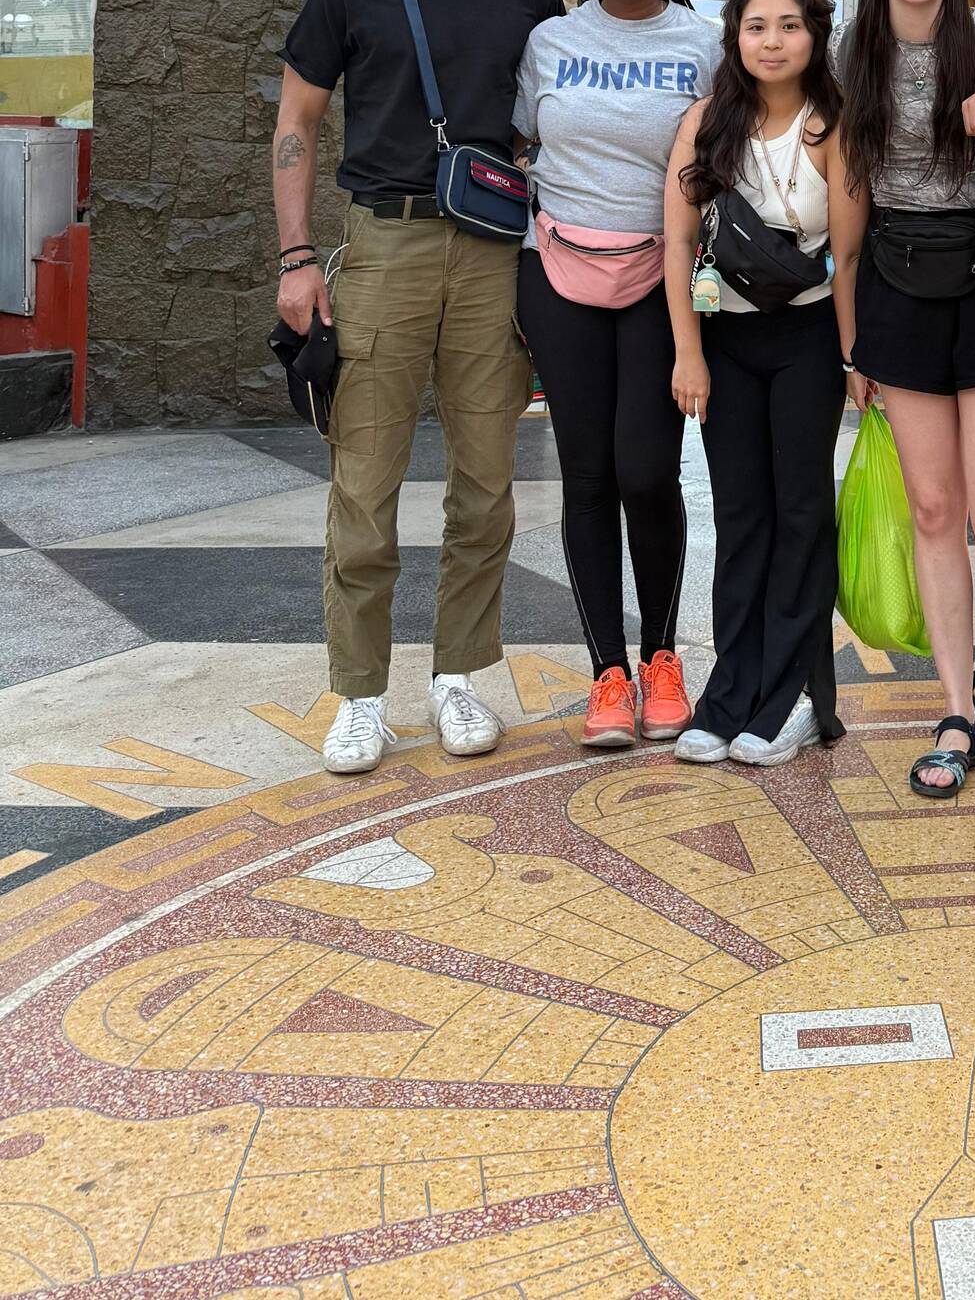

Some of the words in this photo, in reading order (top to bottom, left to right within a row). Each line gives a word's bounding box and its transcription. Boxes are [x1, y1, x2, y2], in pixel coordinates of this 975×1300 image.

[556, 56, 698, 93] WINNER
[486, 171, 511, 188] NAUTICA
[690, 257, 700, 293] TAIWAN
